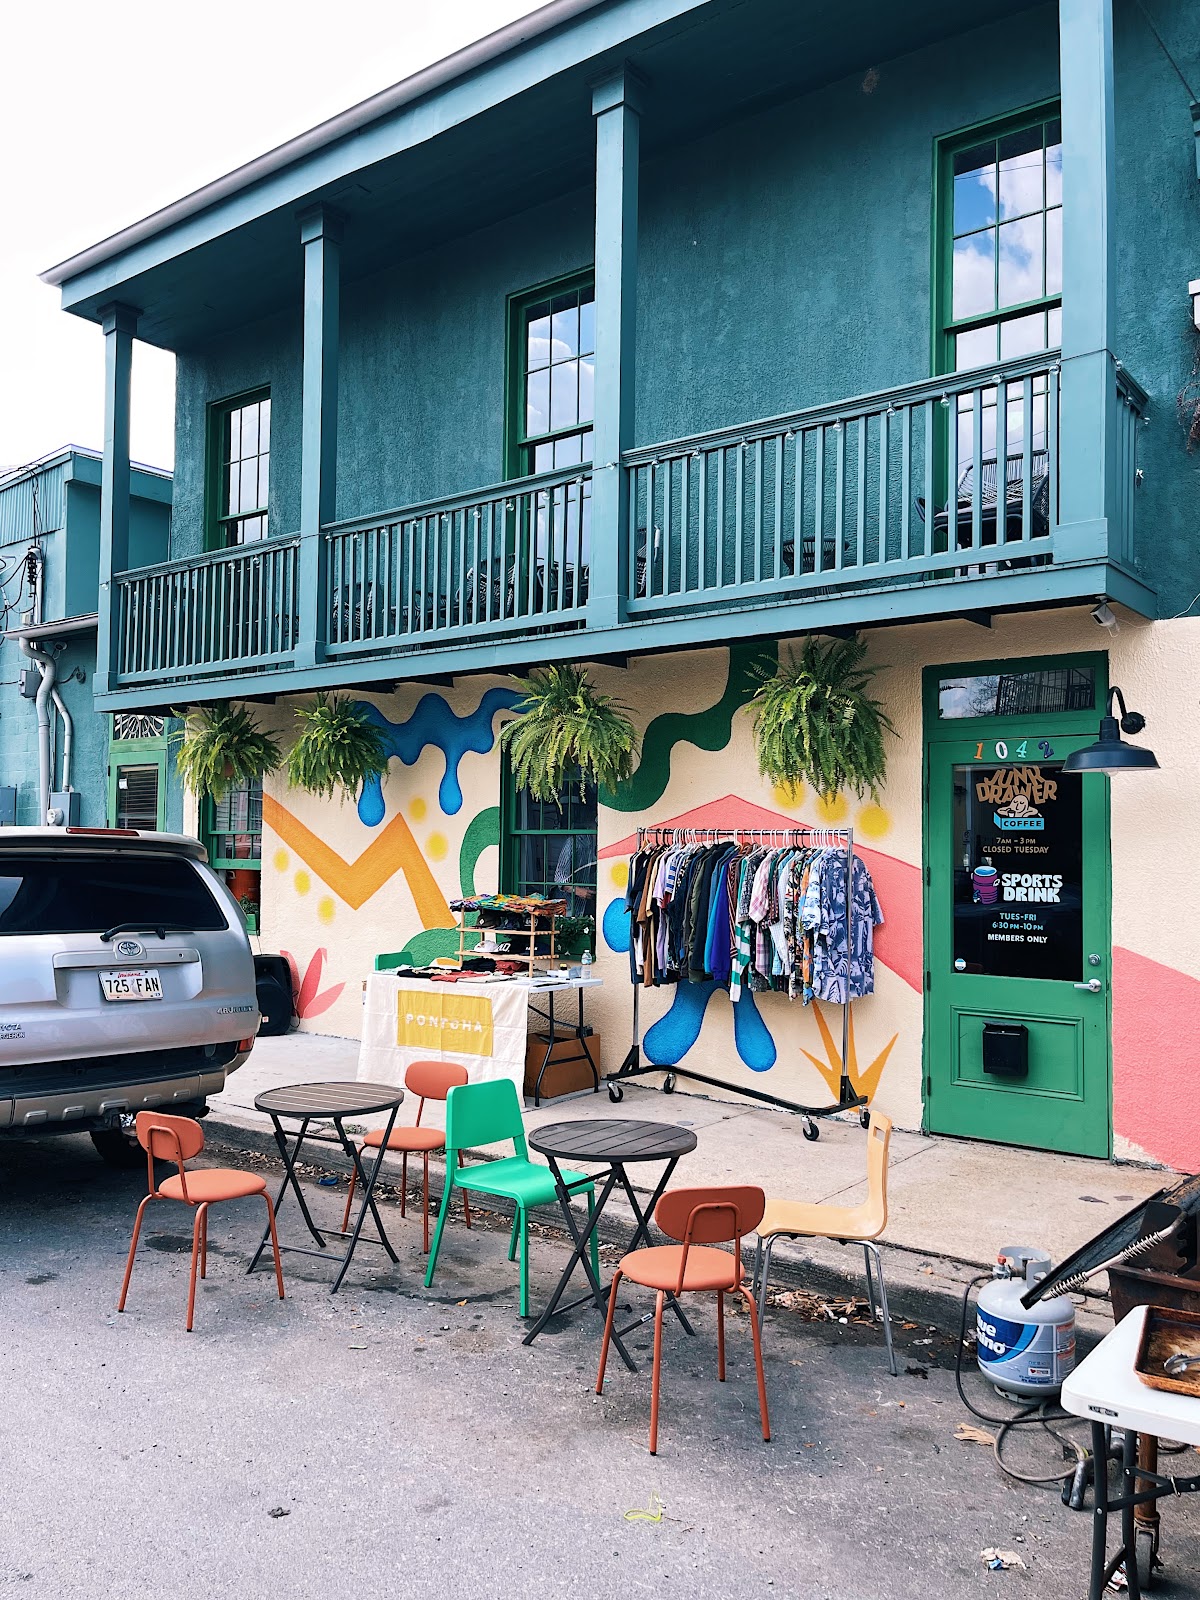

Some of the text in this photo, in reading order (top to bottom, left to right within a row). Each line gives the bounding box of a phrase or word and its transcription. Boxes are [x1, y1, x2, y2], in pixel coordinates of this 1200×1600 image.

[974, 740, 1054, 759] 1042
[984, 765, 1045, 788] JUNK
[976, 780, 1058, 804] DRAWER
[1001, 874, 1063, 888] SPORTS
[1003, 887, 1060, 902] DRINK
[999, 913, 1037, 921] TUES-FRI
[987, 934, 1048, 943] MEMBERS ONLY
[105, 977, 159, 993] 725 FAN
